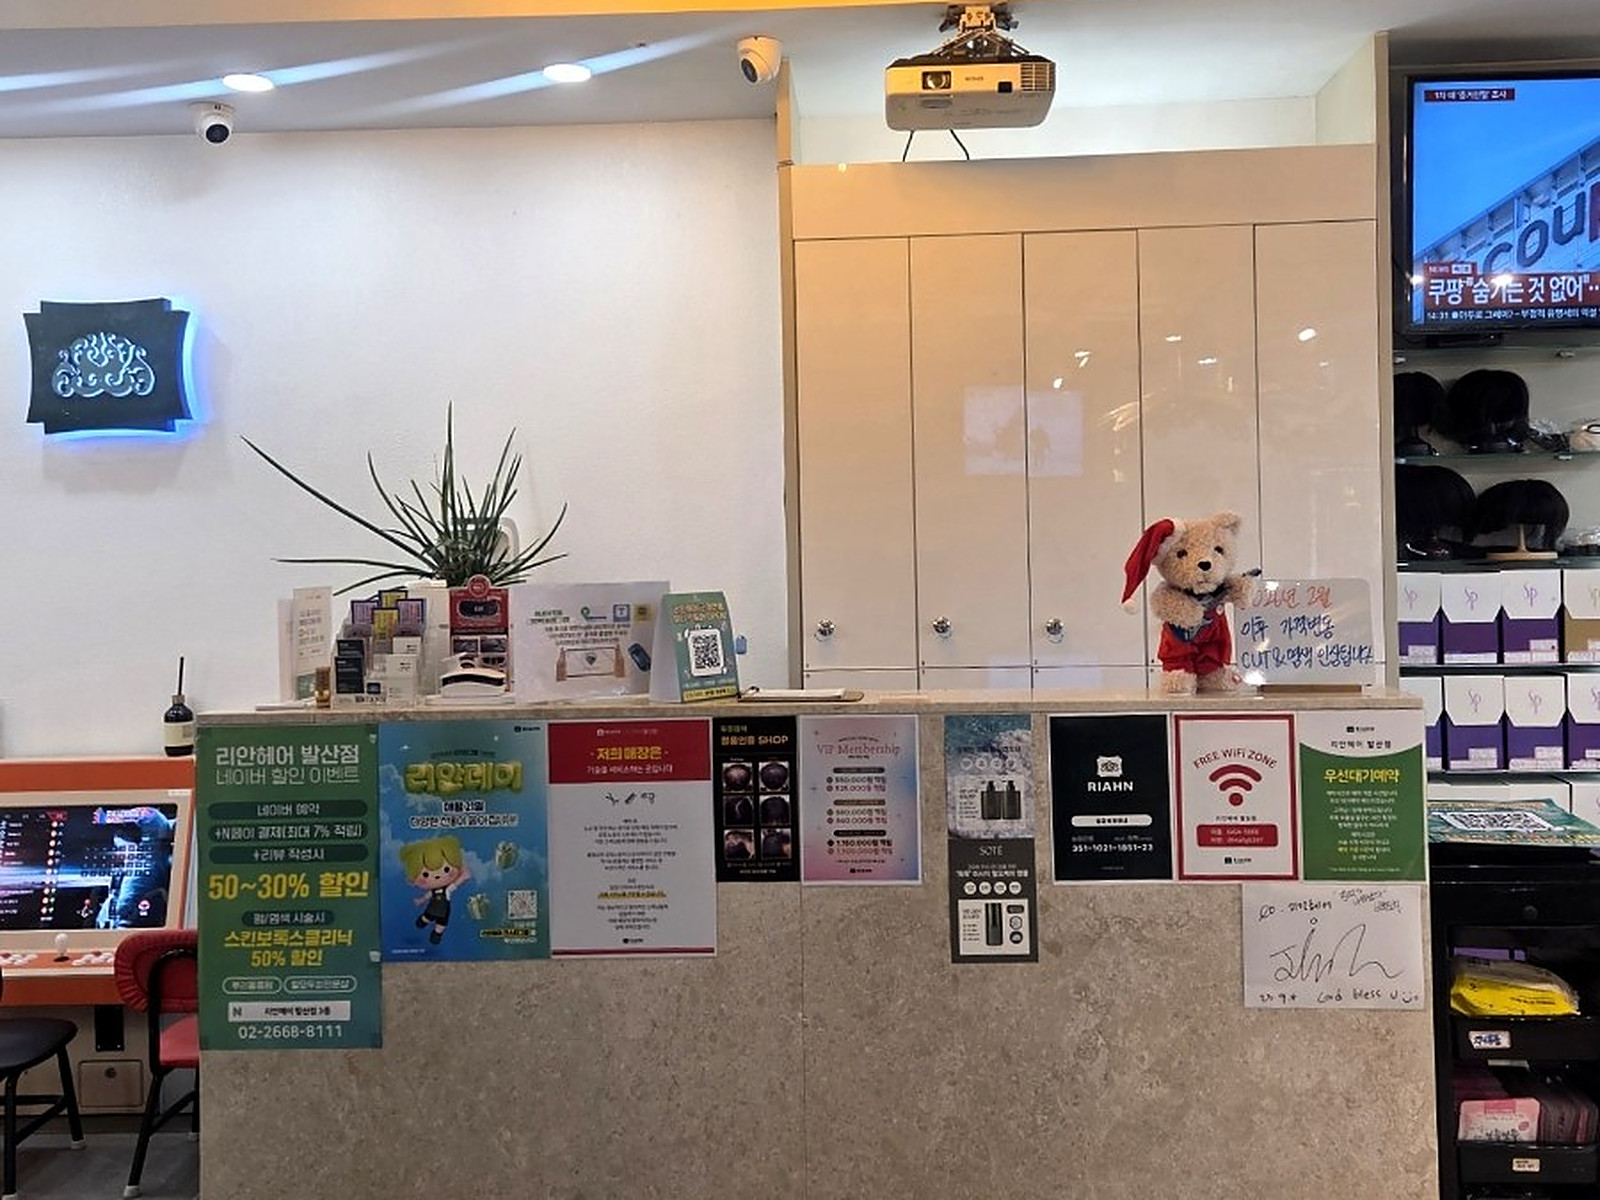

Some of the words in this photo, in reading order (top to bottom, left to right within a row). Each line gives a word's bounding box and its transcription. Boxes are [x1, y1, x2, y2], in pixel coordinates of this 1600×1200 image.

[1428, 278, 1464, 305] 쿠팡
[1529, 276, 1545, 303] 것
[1250, 587, 1301, 609] 026년
[1241, 615, 1269, 642] 이후
[1280, 613, 1335, 640] 가격변동
[758, 735, 788, 745] SHOP
[216, 745, 293, 766] 리안헤어
[301, 744, 360, 765] 발산점
[597, 746, 623, 760] 저희
[624, 745, 662, 760] 매장은
[1193, 751, 1221, 769] FREE
[1247, 749, 1277, 769] ZONE
[216, 768, 266, 785] 네이버
[271, 767, 304, 785] 할인
[309, 766, 360, 784] 이벤트
[405, 760, 523, 795] 리안데이
[1323, 768, 1401, 784] 우선대기예약
[1087, 781, 1134, 792] RIAHN
[208, 873, 309, 900] 50~30%
[319, 871, 370, 898] 할인
[251, 950, 285, 967] 50%
[291, 949, 323, 966] 할인
[238, 1024, 342, 1040] 02-2668-8111
